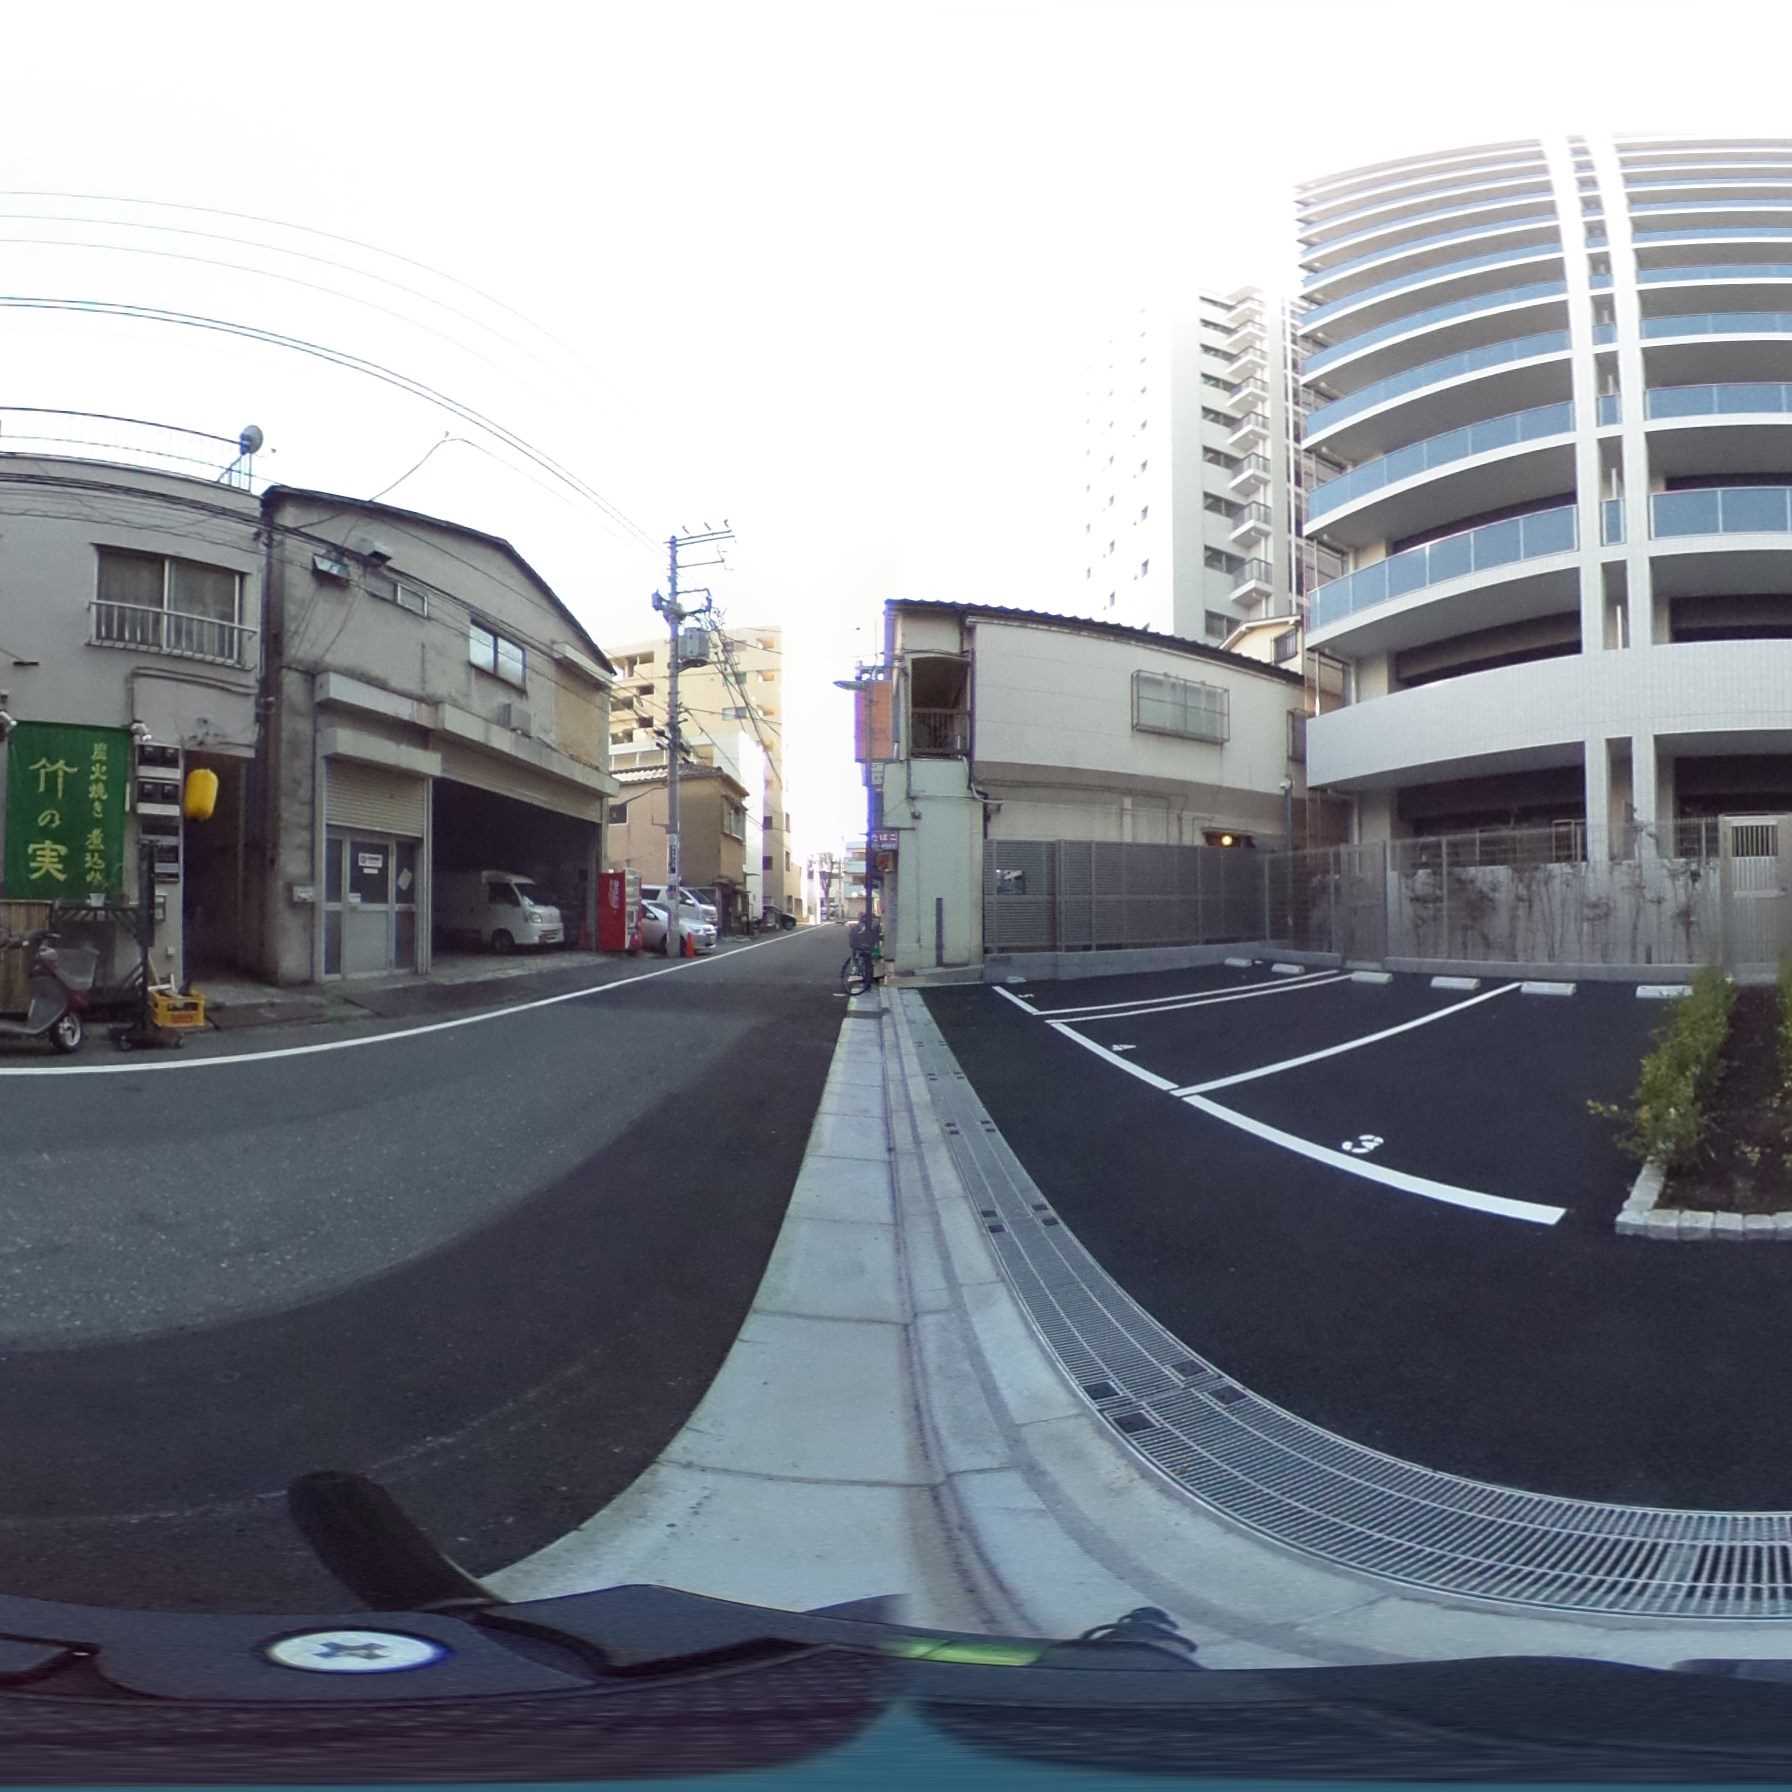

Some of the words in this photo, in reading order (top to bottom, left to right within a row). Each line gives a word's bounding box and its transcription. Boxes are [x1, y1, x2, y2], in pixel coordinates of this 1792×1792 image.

[28, 756, 79, 882] 竹の実
[1341, 1134, 1384, 1154] 3
